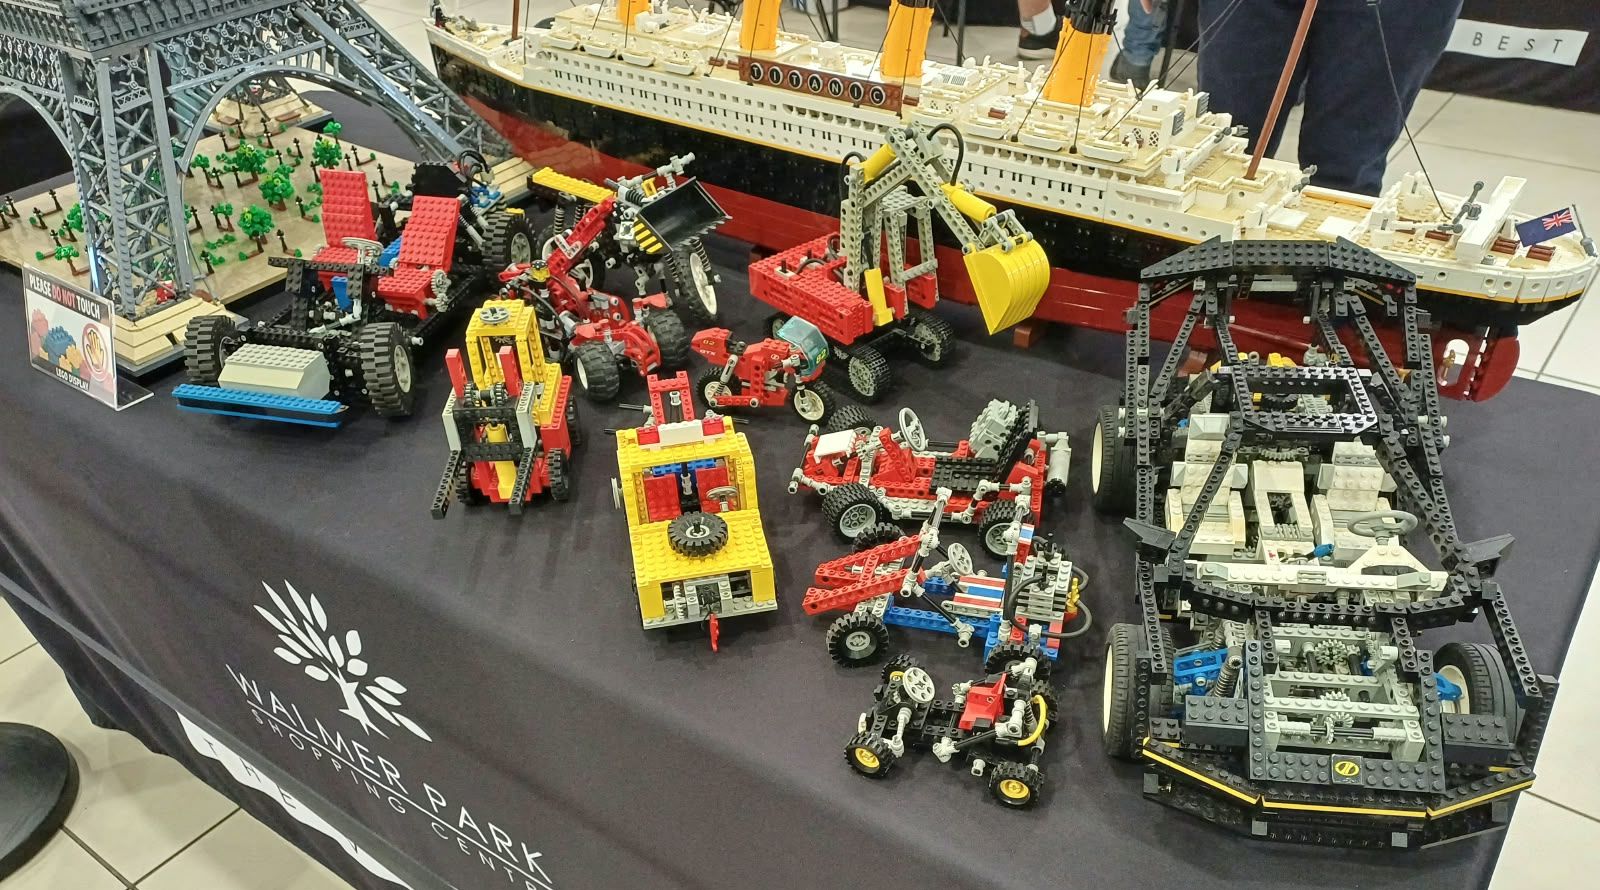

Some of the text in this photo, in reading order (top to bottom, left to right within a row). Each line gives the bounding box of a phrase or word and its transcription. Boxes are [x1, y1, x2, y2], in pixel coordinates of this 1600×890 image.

[1472, 31, 1563, 54] BEST
[751, 65, 883, 103] TITANIC
[29, 274, 101, 320] PLEASE DO NOT TOUCH
[55, 367, 90, 391] LEGO DISPLAY
[203, 738, 297, 809] THE
[225, 663, 553, 884] WALMER PARK
[251, 708, 406, 814] SHOPPING
